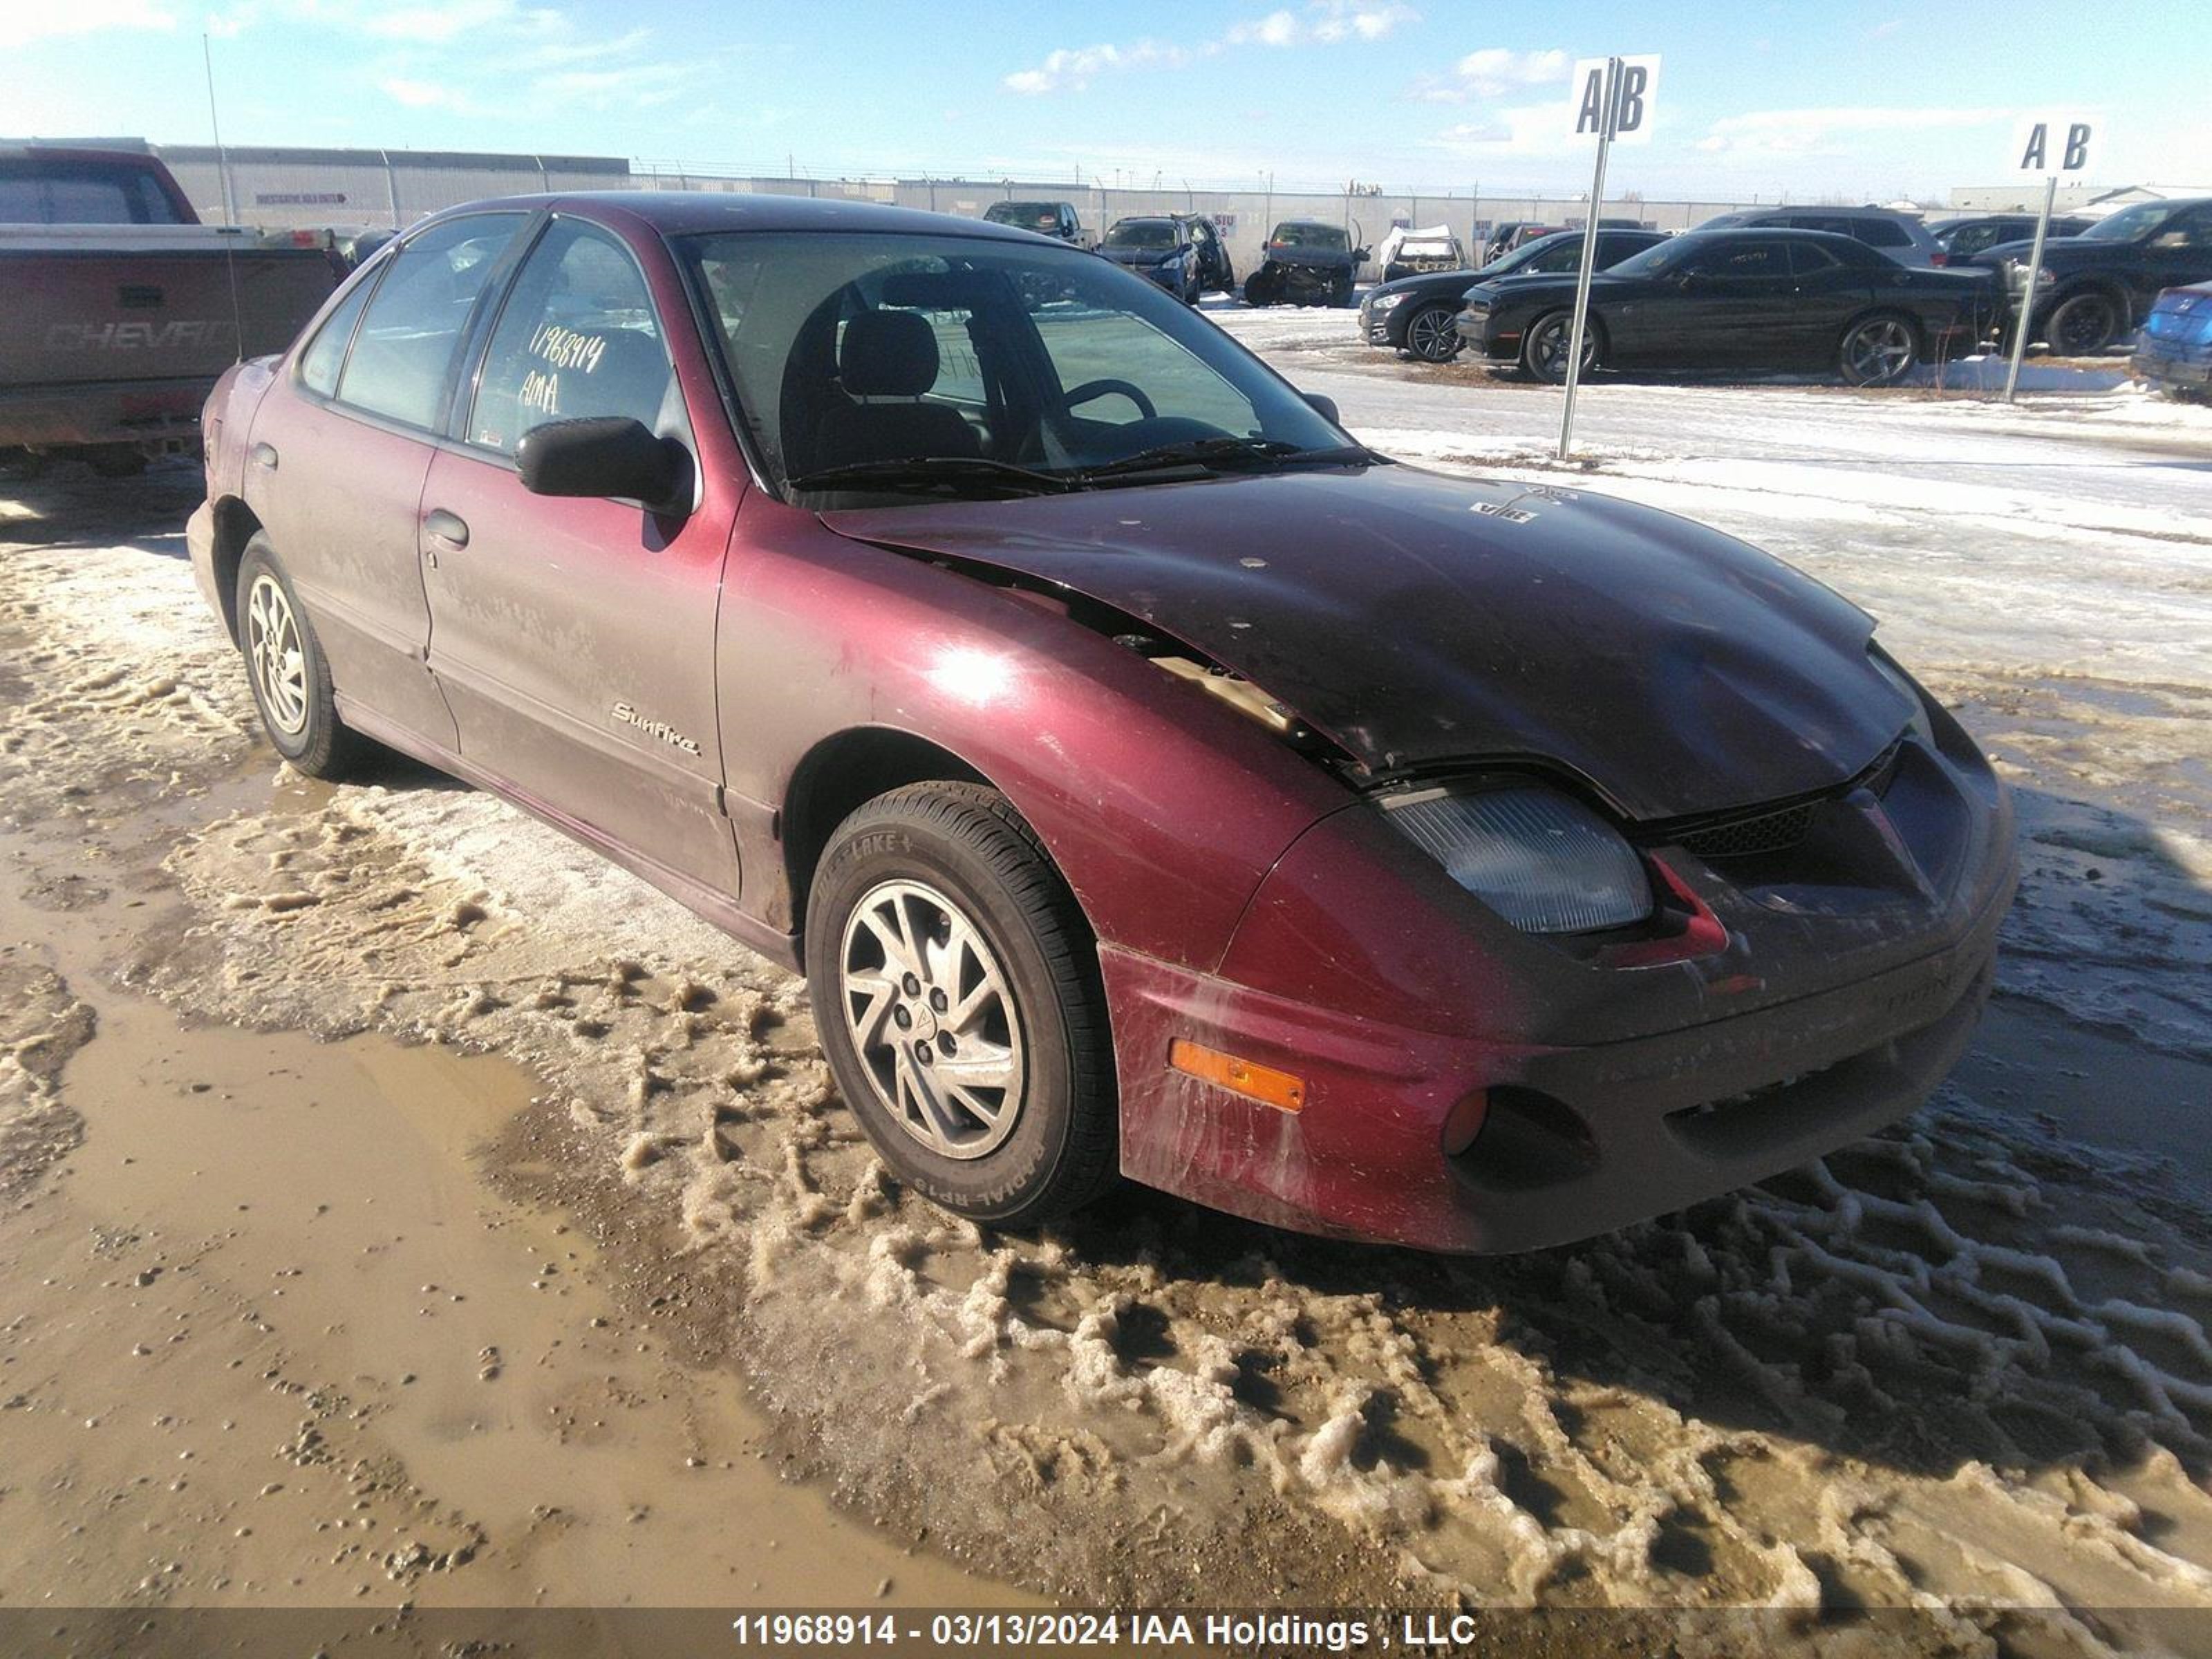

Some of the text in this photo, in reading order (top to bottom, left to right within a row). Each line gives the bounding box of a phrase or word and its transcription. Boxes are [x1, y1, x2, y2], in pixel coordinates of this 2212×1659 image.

[1576, 66, 1647, 133] A B
[2020, 123, 2092, 170] A B
[1215, 214, 1233, 225] SIU
[528, 322, 606, 374] 11968914
[519, 369, 558, 415] AMA
